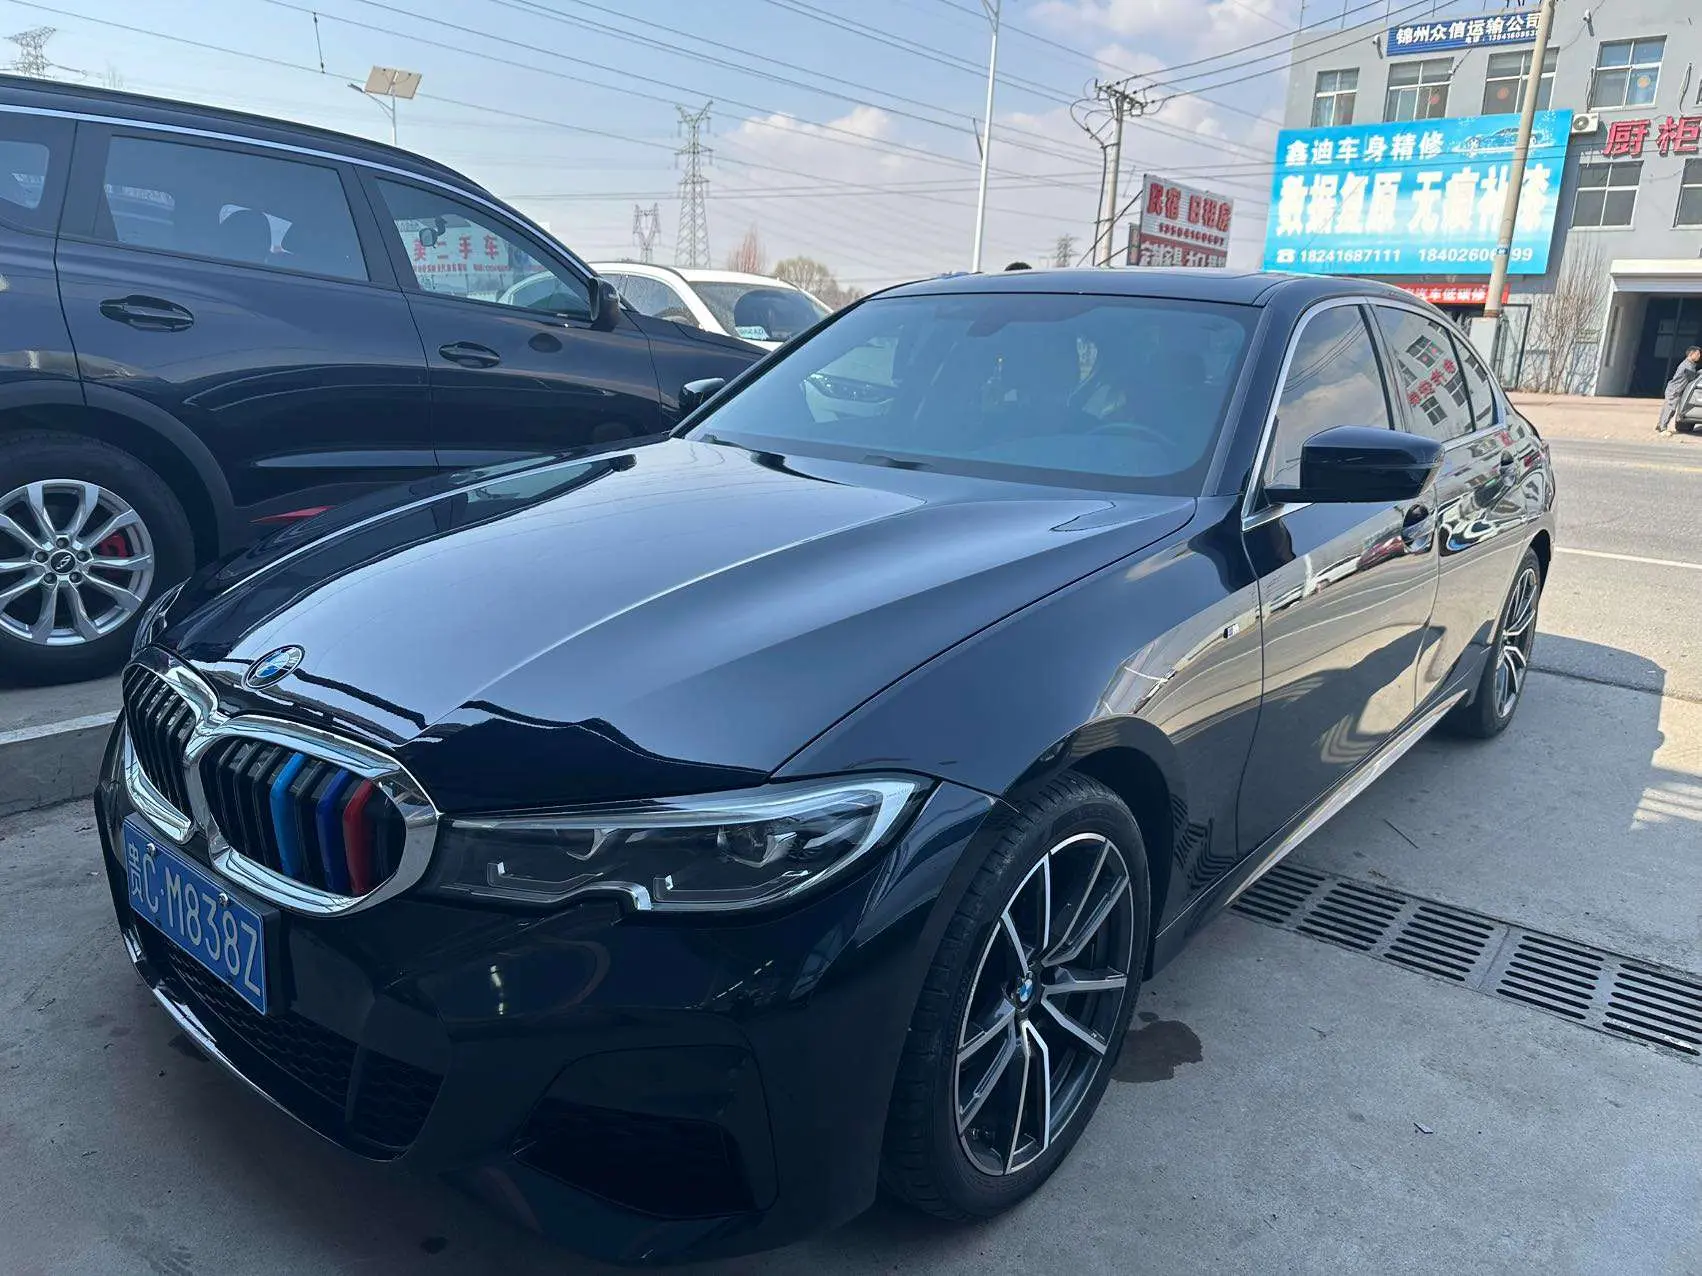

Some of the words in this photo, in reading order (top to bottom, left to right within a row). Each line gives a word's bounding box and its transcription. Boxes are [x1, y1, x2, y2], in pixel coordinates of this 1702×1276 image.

[1396, 12, 1542, 45] 锦州众信运输公司
[1285, 130, 1444, 167] 鑫迪车身精修
[1300, 248, 1401, 263] 18241687111
[1418, 248, 1533, 262] 1840260699
